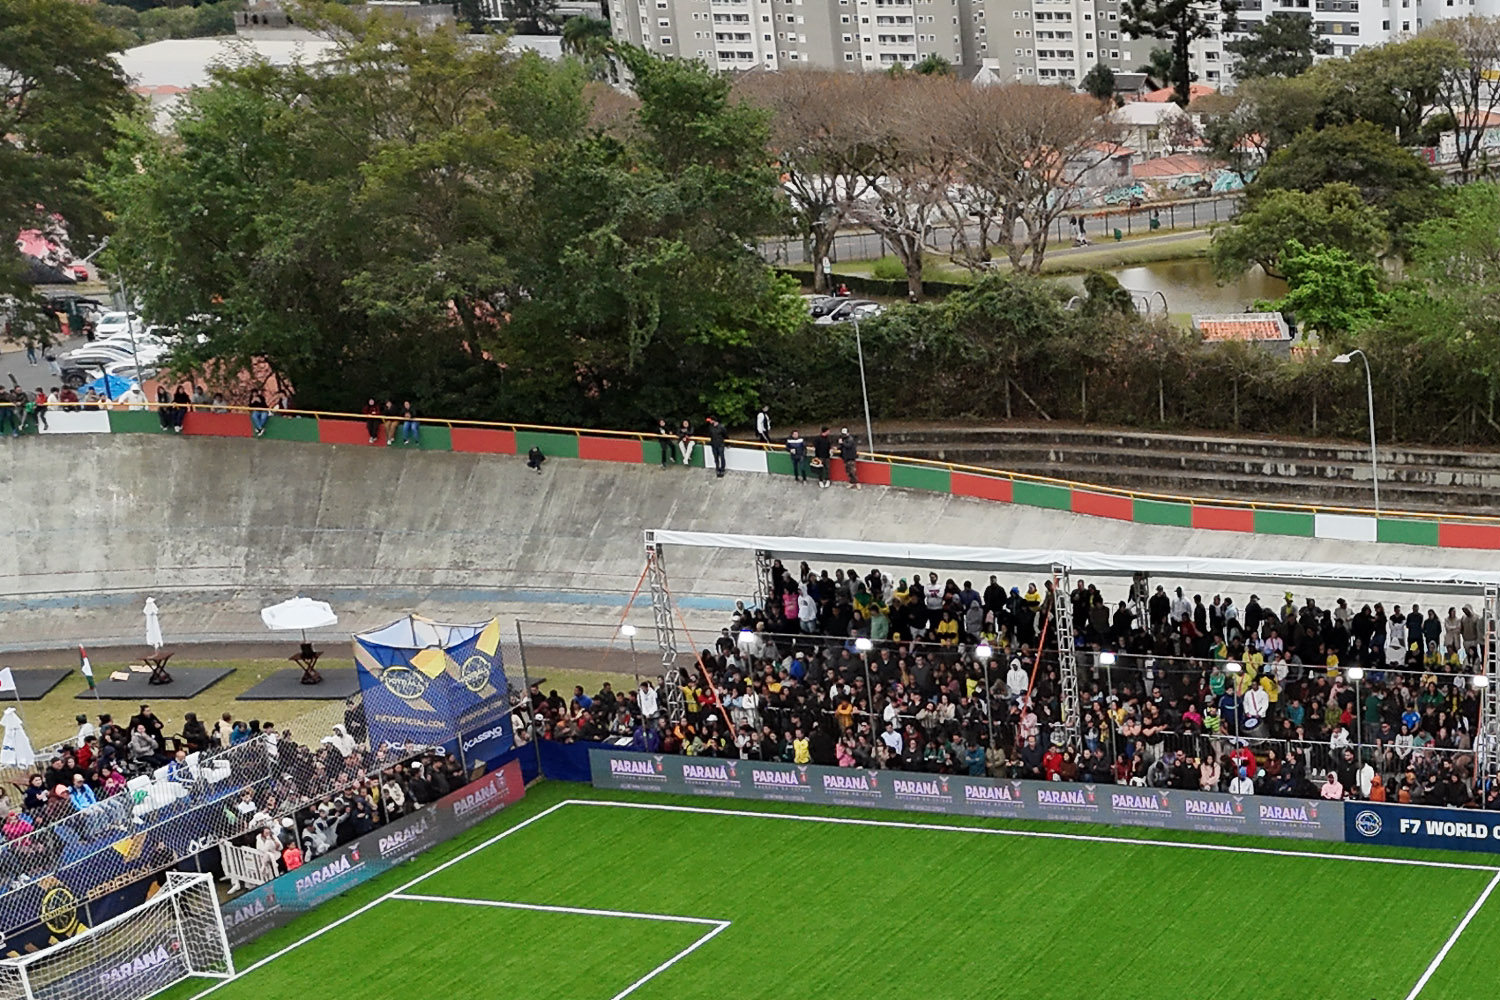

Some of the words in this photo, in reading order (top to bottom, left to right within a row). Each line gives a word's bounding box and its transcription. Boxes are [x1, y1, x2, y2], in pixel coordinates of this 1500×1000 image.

[610, 759, 655, 775] PARANÁ
[683, 764, 728, 780] PARANÁ
[752, 769, 798, 785] PARANÁ
[823, 774, 869, 790] PARANÁ
[894, 780, 939, 796] PARANÁ
[964, 785, 1011, 800] PARANÁ
[1038, 789, 1086, 805] PARANÁ
[1112, 794, 1159, 809] PARANÁ
[1185, 799, 1233, 815] PARANÁ
[1259, 805, 1308, 821] PARANÁ
[1400, 818, 1421, 834] F7
[1425, 820, 1488, 839] WORLD
